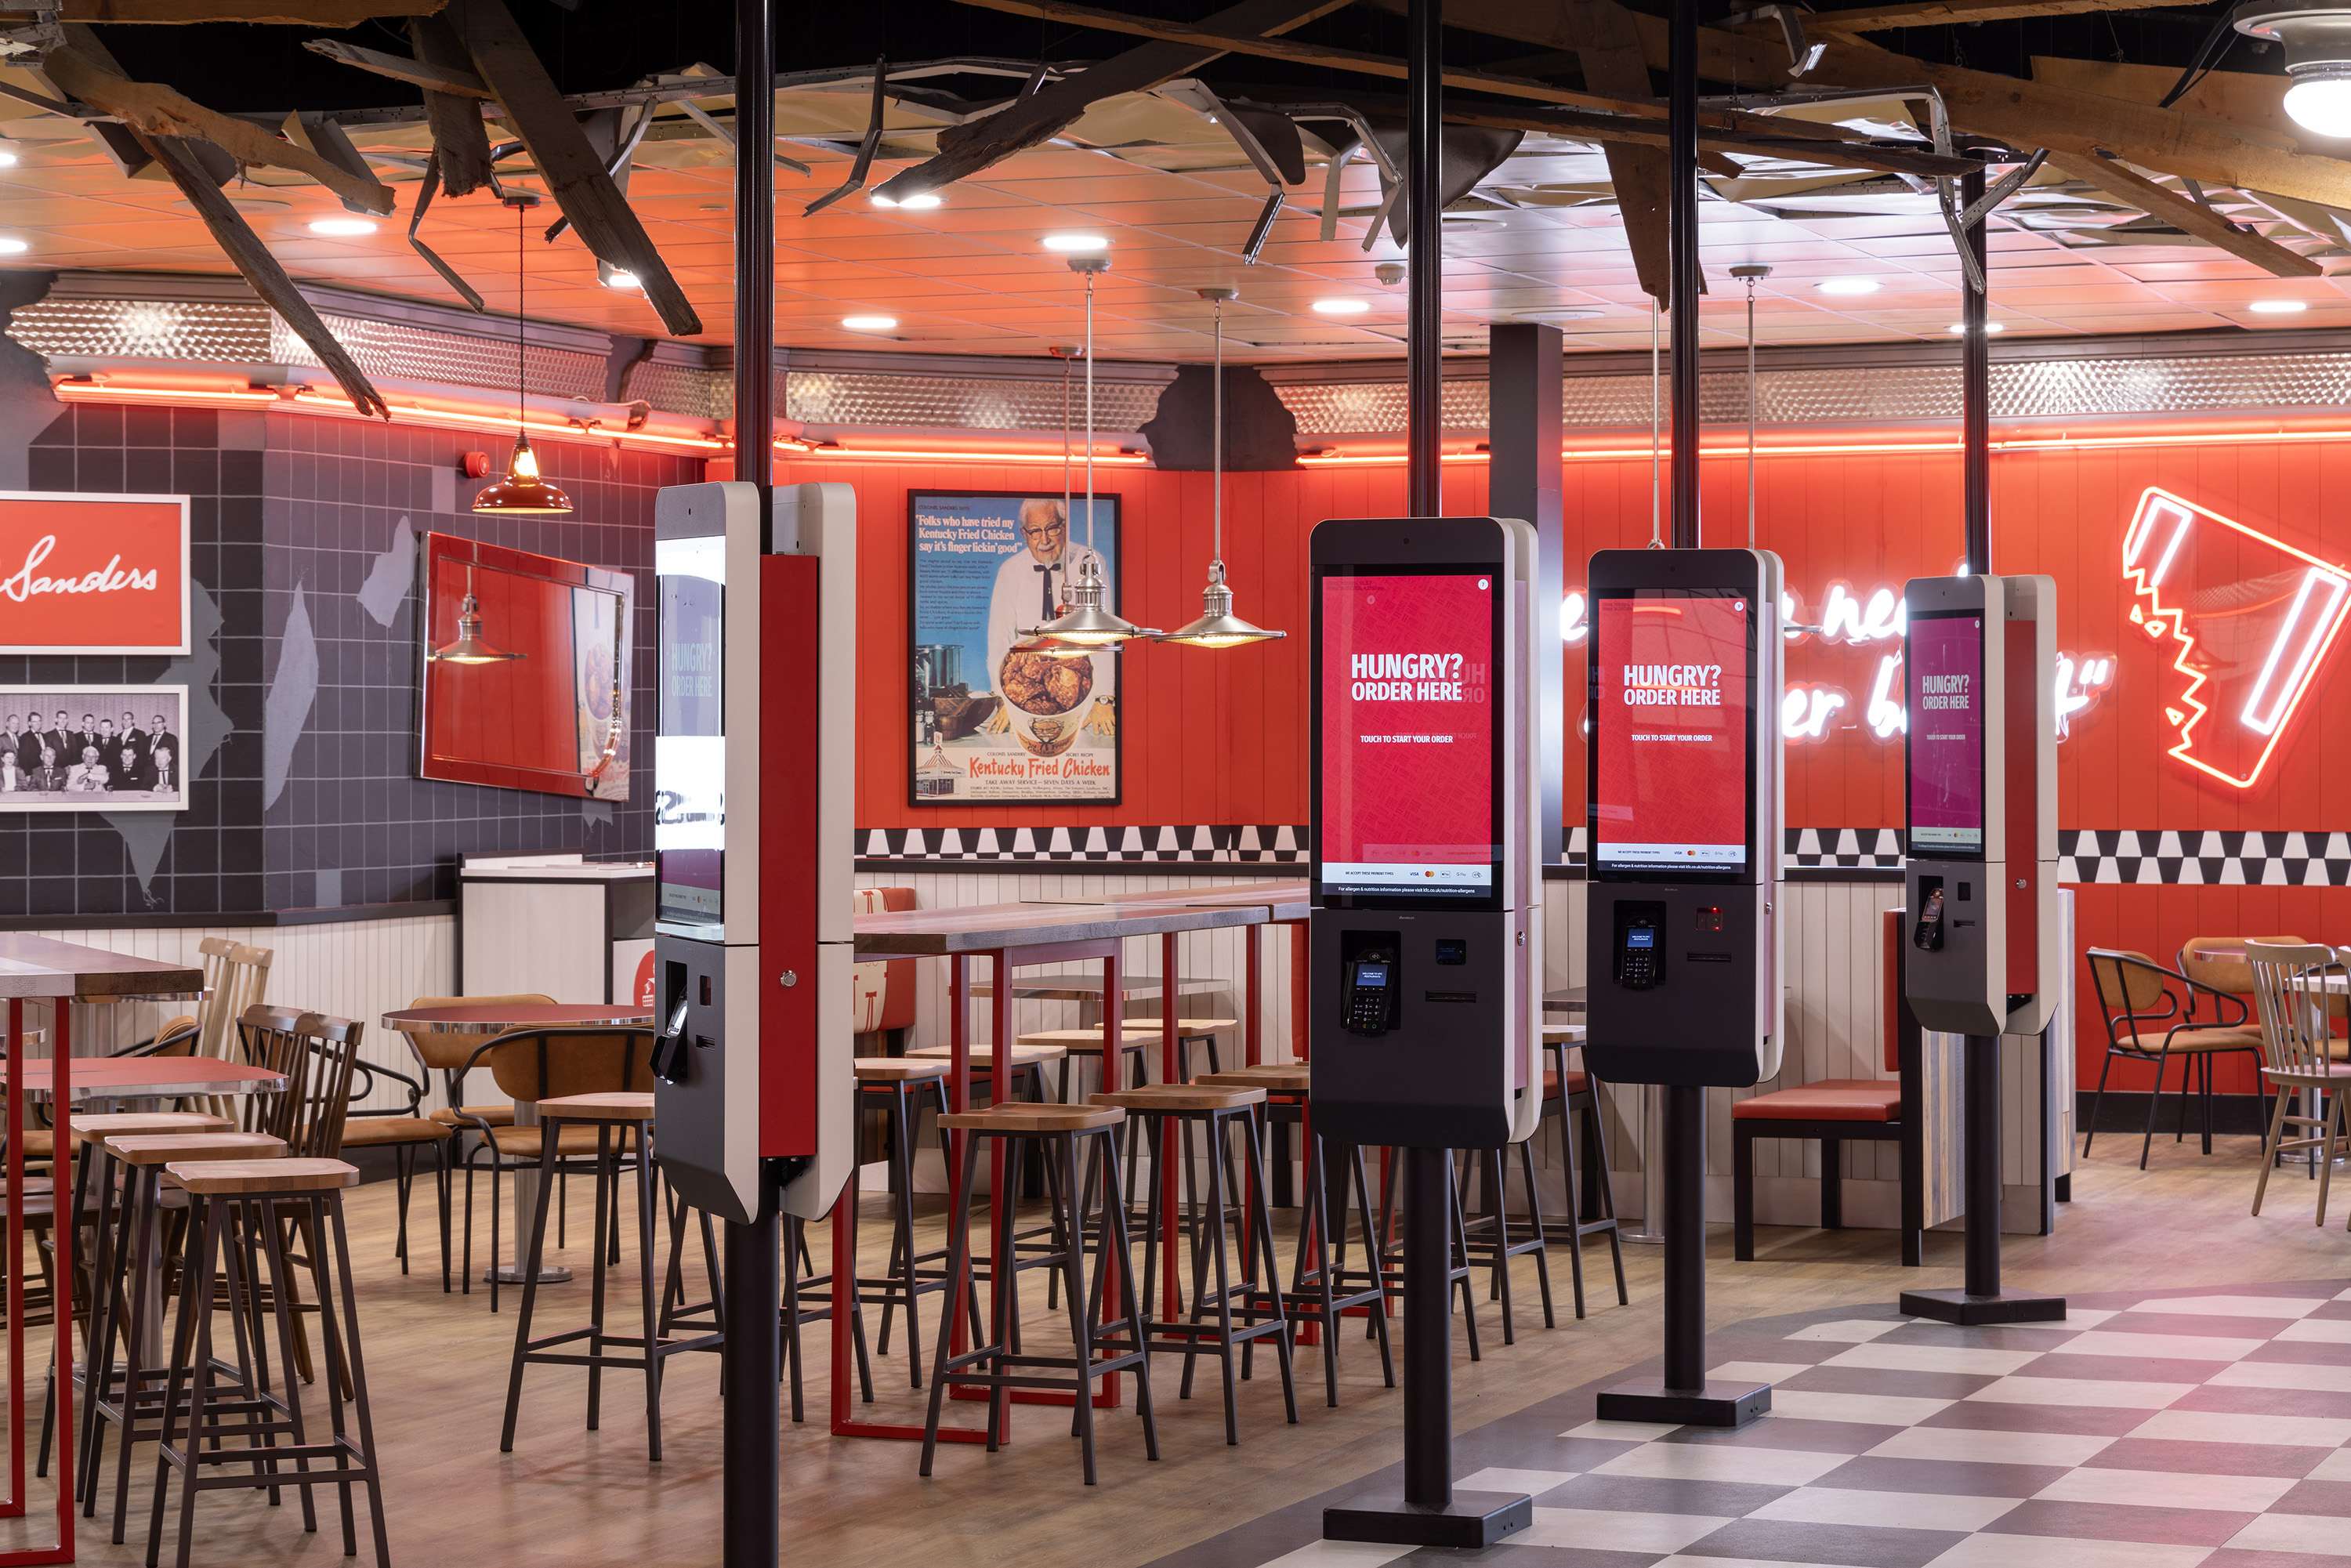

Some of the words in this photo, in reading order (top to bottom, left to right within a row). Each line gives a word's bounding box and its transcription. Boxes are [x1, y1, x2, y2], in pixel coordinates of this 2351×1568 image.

[943, 516, 960, 527] who
[962, 516, 980, 527] have
[981, 517, 1001, 527] tried
[1002, 520, 1014, 529] my
[918, 527, 957, 541] Kentucky
[958, 529, 980, 539] Fried
[981, 529, 1014, 540] Chicken
[919, 542, 933, 553] say
[934, 541, 947, 551] it's
[947, 541, 972, 553] finger
[5, 534, 157, 602] Sanders
[672, 643, 712, 672] HUNGRY?
[1352, 653, 1463, 679] HUNGRY?
[1624, 664, 1722, 686] HUNGRY?
[1922, 675, 1969, 693] HUNGRY?
[672, 675, 694, 697] ORDER
[695, 676, 712, 697] HERE
[1352, 682, 1413, 701] ORDER
[1417, 683, 1462, 701] HERE
[1624, 689, 1677, 705] ORDER
[1681, 690, 1720, 705] HERE
[1922, 696, 1948, 710] ORDER
[1950, 695, 1969, 709] HERE
[970, 757, 1024, 778] Kentucky
[1027, 758, 1059, 779] Fried
[1063, 758, 1110, 779] Chicken
